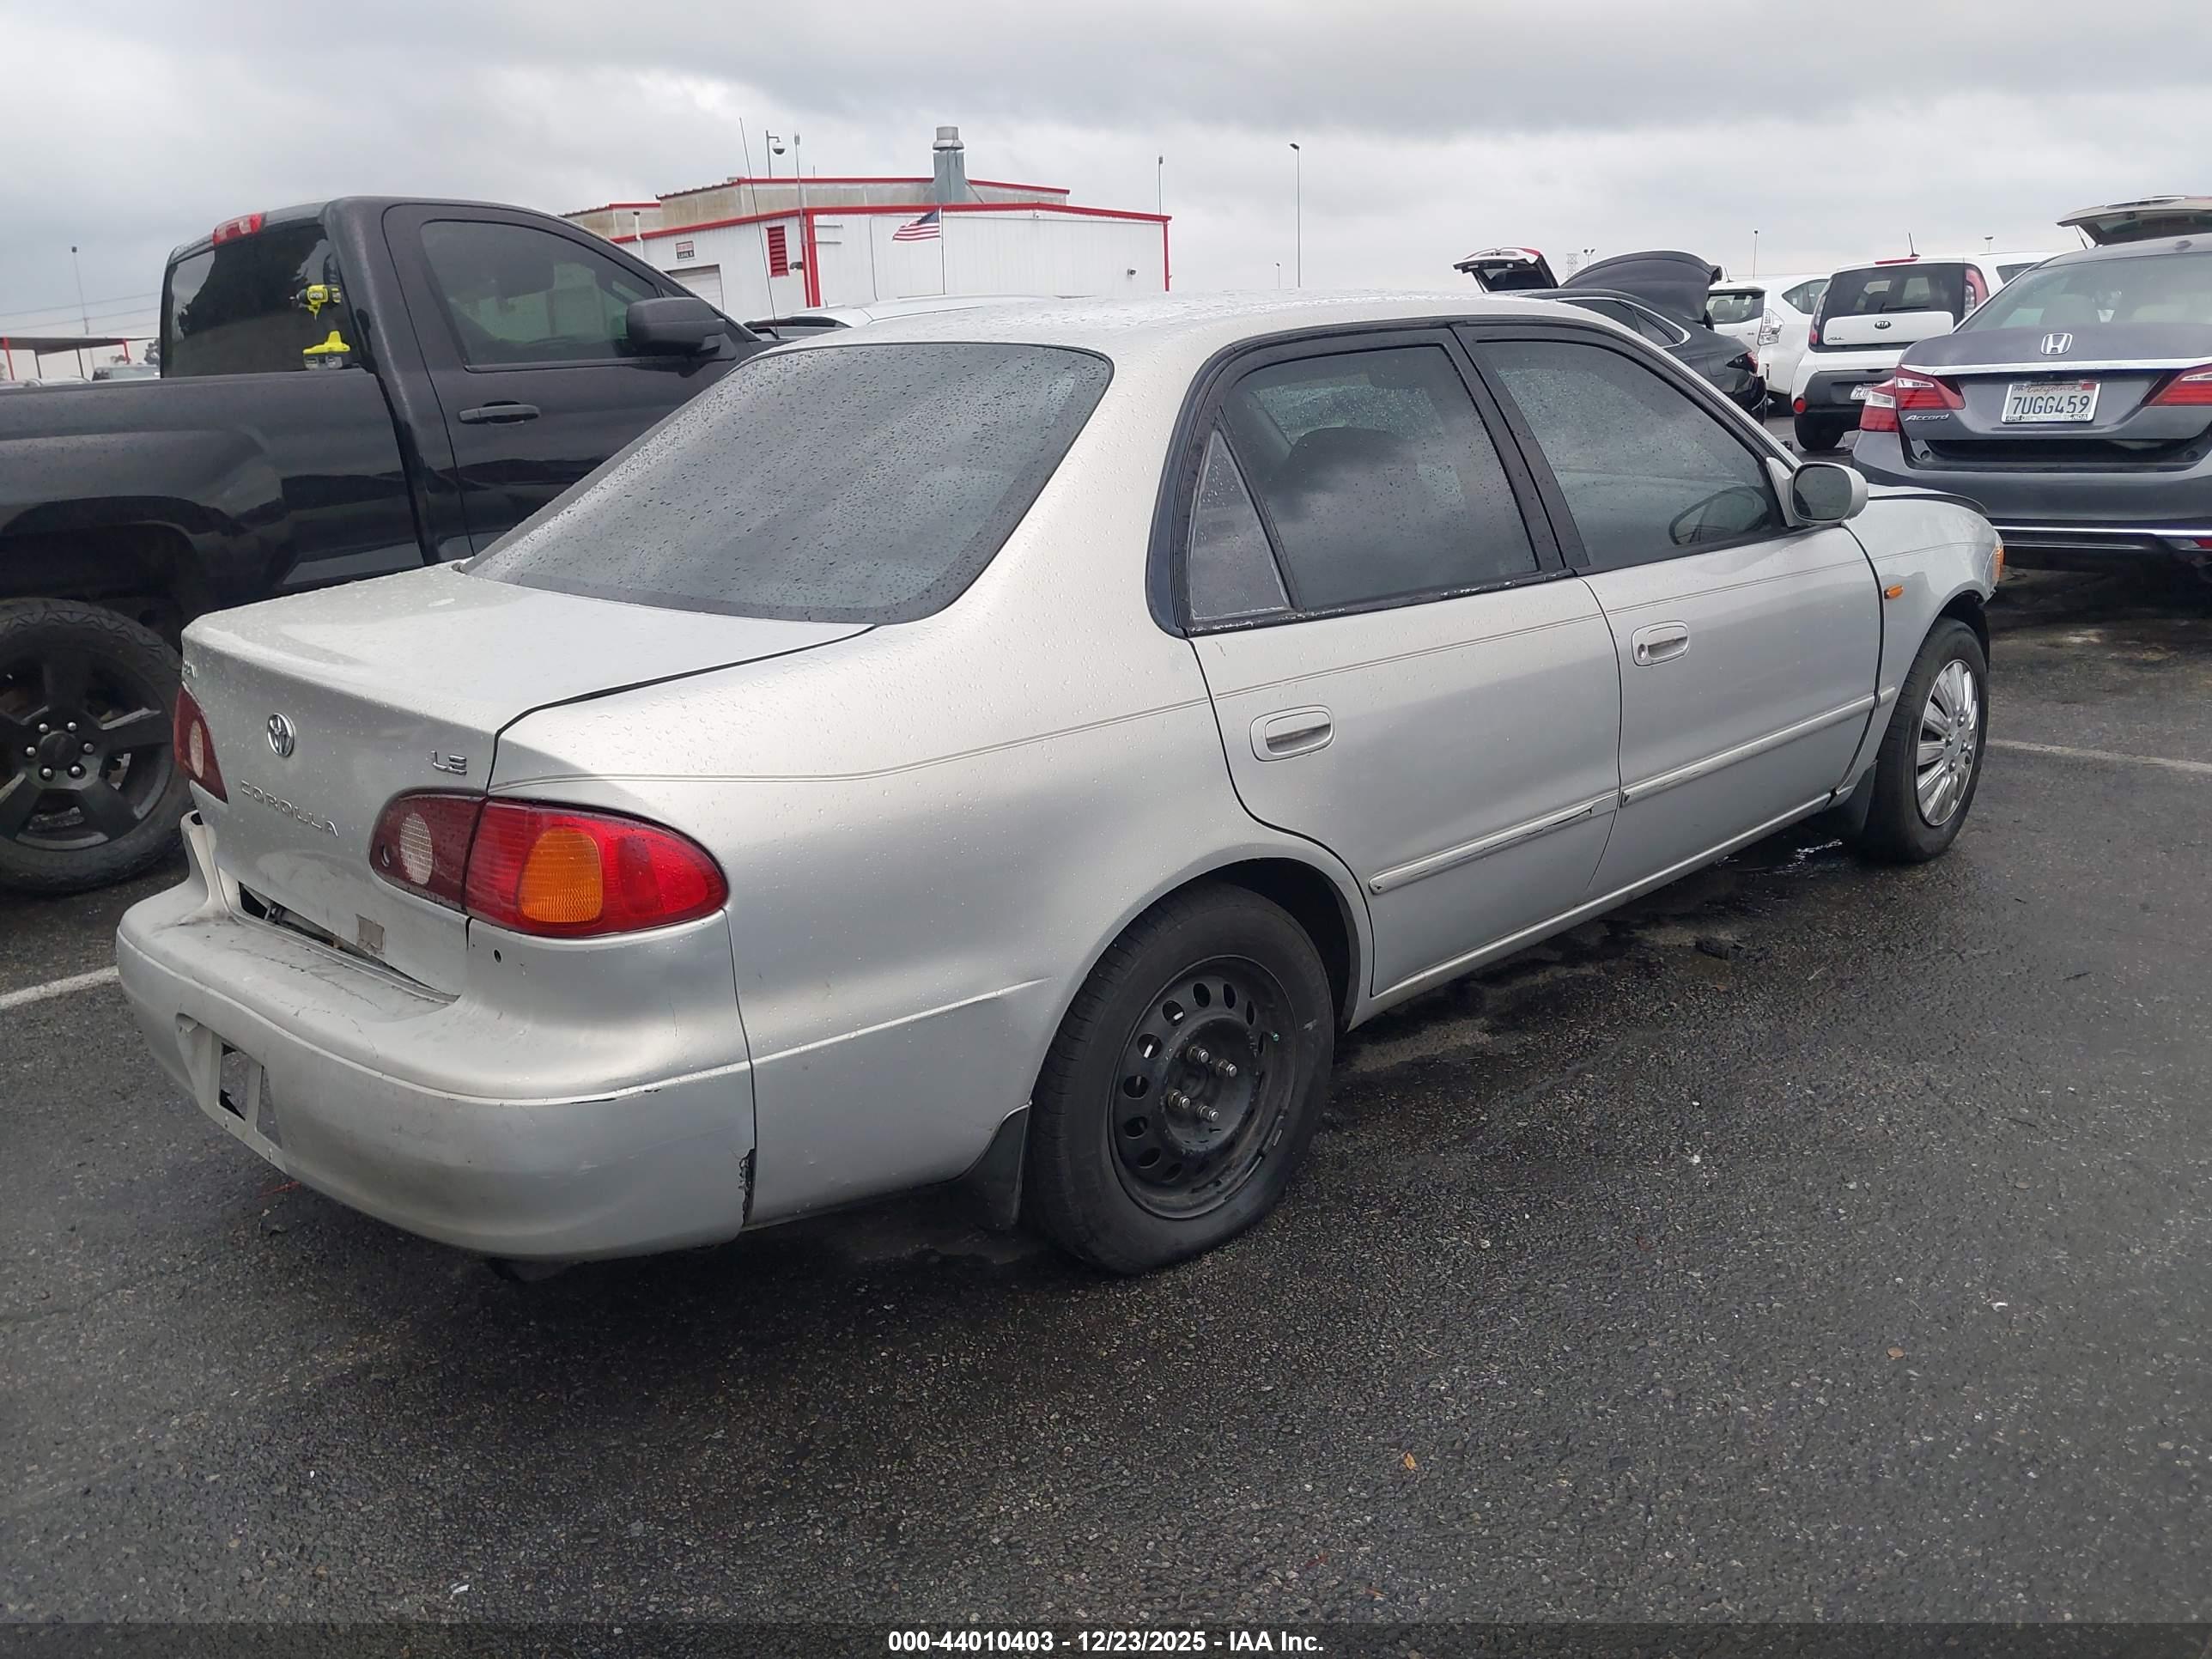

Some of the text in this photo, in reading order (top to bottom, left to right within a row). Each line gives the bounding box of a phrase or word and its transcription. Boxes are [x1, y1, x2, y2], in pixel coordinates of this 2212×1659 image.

[2012, 395, 2090, 415] 7UGG459
[1904, 413, 1950, 422] Accord
[430, 749, 468, 776] LE
[240, 779, 339, 838] COROLLA
